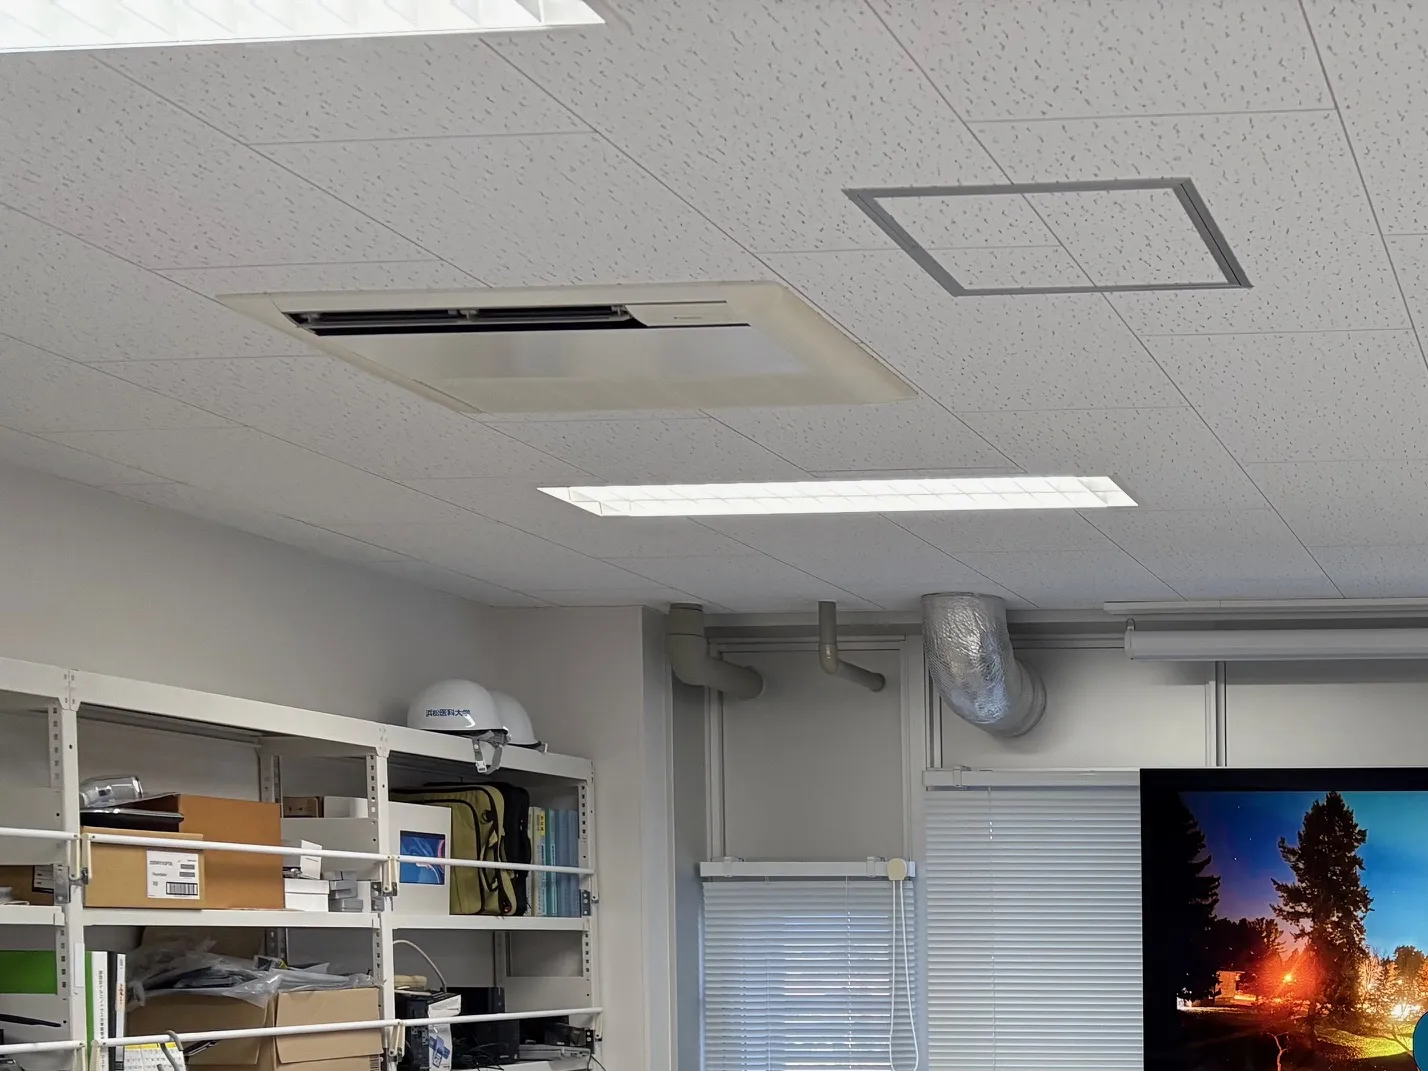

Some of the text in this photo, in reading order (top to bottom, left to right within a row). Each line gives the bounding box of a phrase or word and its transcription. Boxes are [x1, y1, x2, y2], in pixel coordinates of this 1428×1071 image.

[425, 709, 471, 717] 浜松医科大学
